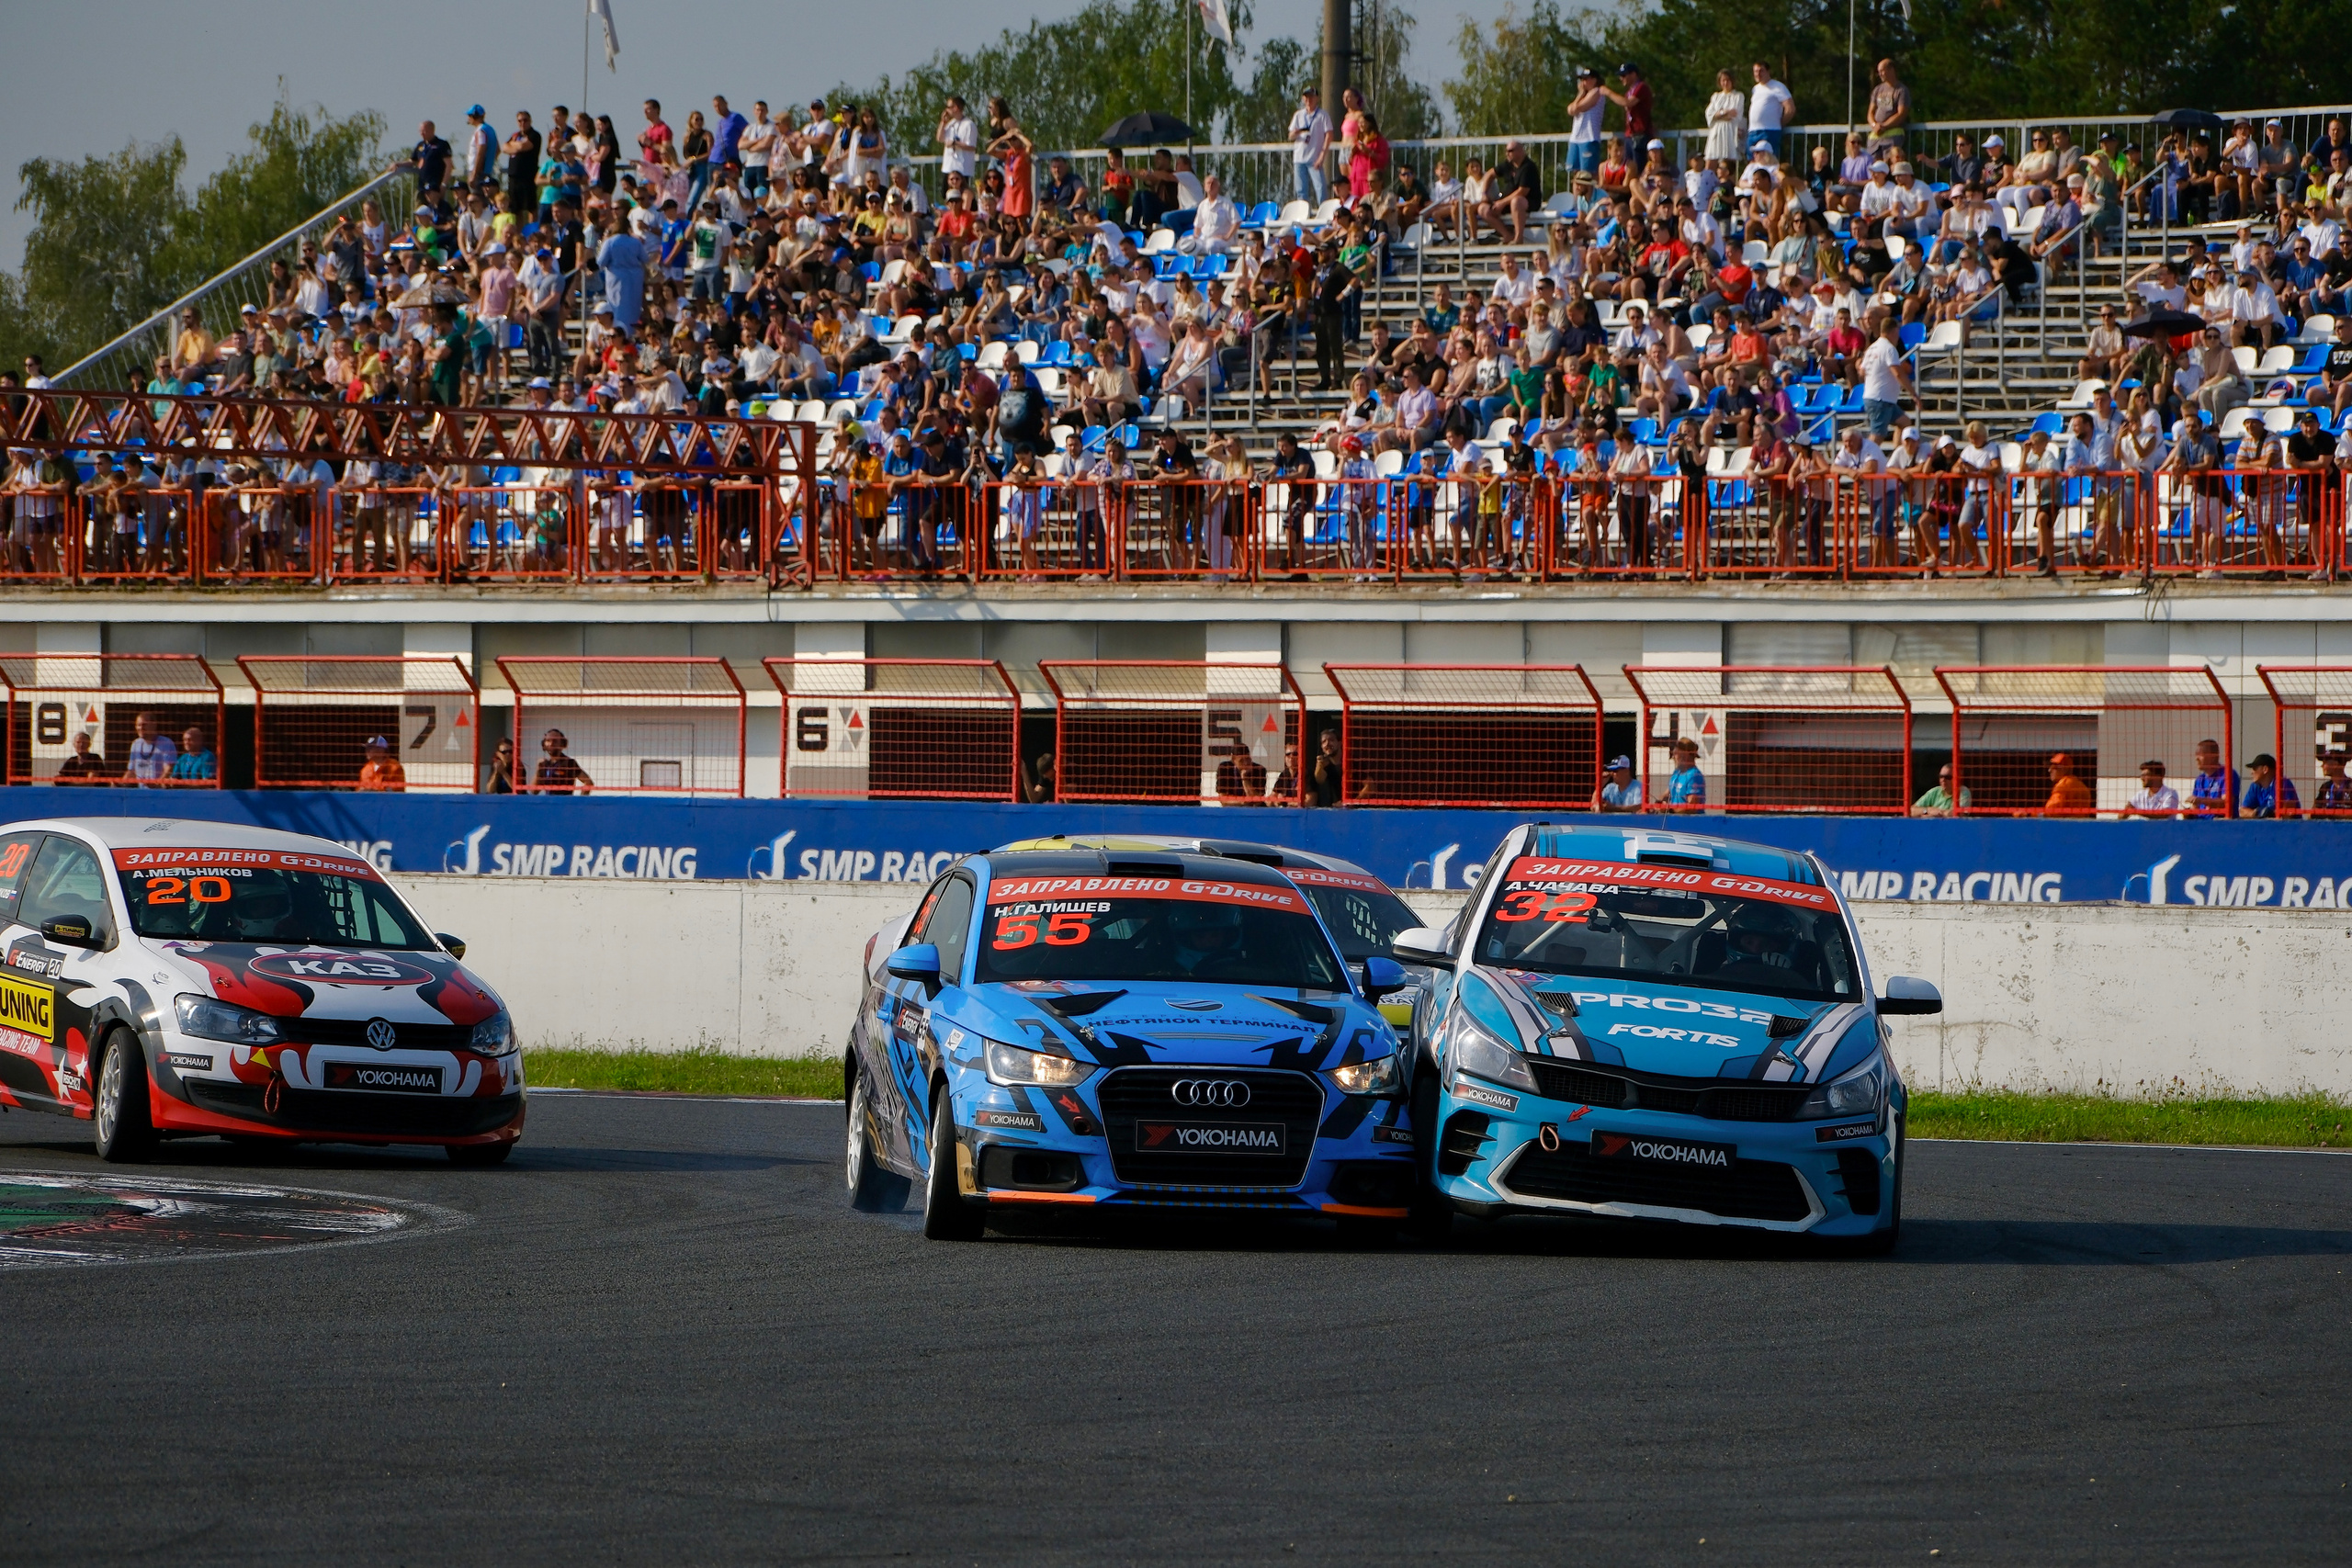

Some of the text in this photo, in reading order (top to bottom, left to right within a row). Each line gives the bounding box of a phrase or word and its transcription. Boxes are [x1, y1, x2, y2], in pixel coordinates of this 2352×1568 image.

[38, 703, 66, 745] 8
[405, 705, 436, 749] 7
[797, 706, 828, 751] 6
[1207, 709, 1243, 756] 5
[2315, 713, 2352, 761] 3
[0, 842, 30, 878] 20
[126, 851, 271, 865] ЗАПРАВЛЕНО
[490, 842, 698, 879] SMP RACING
[797, 849, 973, 883] SMP RAC
[132, 867, 253, 879] А.МЕЛЬНИКОВ
[1525, 863, 1702, 885] ЗАПРАВЛЕНО
[145, 876, 232, 905] 20
[995, 878, 1170, 897] ЗАПРАВЛЕНО
[1504, 880, 1620, 896] А.ЧАЧАВА
[1833, 870, 2062, 903] MP RACING
[2184, 874, 2274, 907] SMP
[993, 901, 1112, 918] Н.ГАЛИШЕВ
[1494, 891, 1598, 924] 32
[992, 912, 1093, 952] 55
[288, 960, 401, 978] КАЗ
[1088, 1017, 1317, 1033] НЕФТЯНОЙ ТЕРМИНАЛ
[1607, 1022, 1741, 1048] FORTIS
[18, 1034, 41, 1055] TEAM
[170, 1055, 209, 1067] YOKOHAMA
[356, 1069, 436, 1088] YOKOHAMA
[1467, 1089, 1511, 1108] YOKOHAMA
[989, 1114, 1035, 1127] YOKOHAMA
[1835, 1124, 1874, 1138] YOKOHAMA
[1175, 1128, 1279, 1147] YOKOHAMA
[1630, 1140, 1728, 1167] YOKOHAMA
